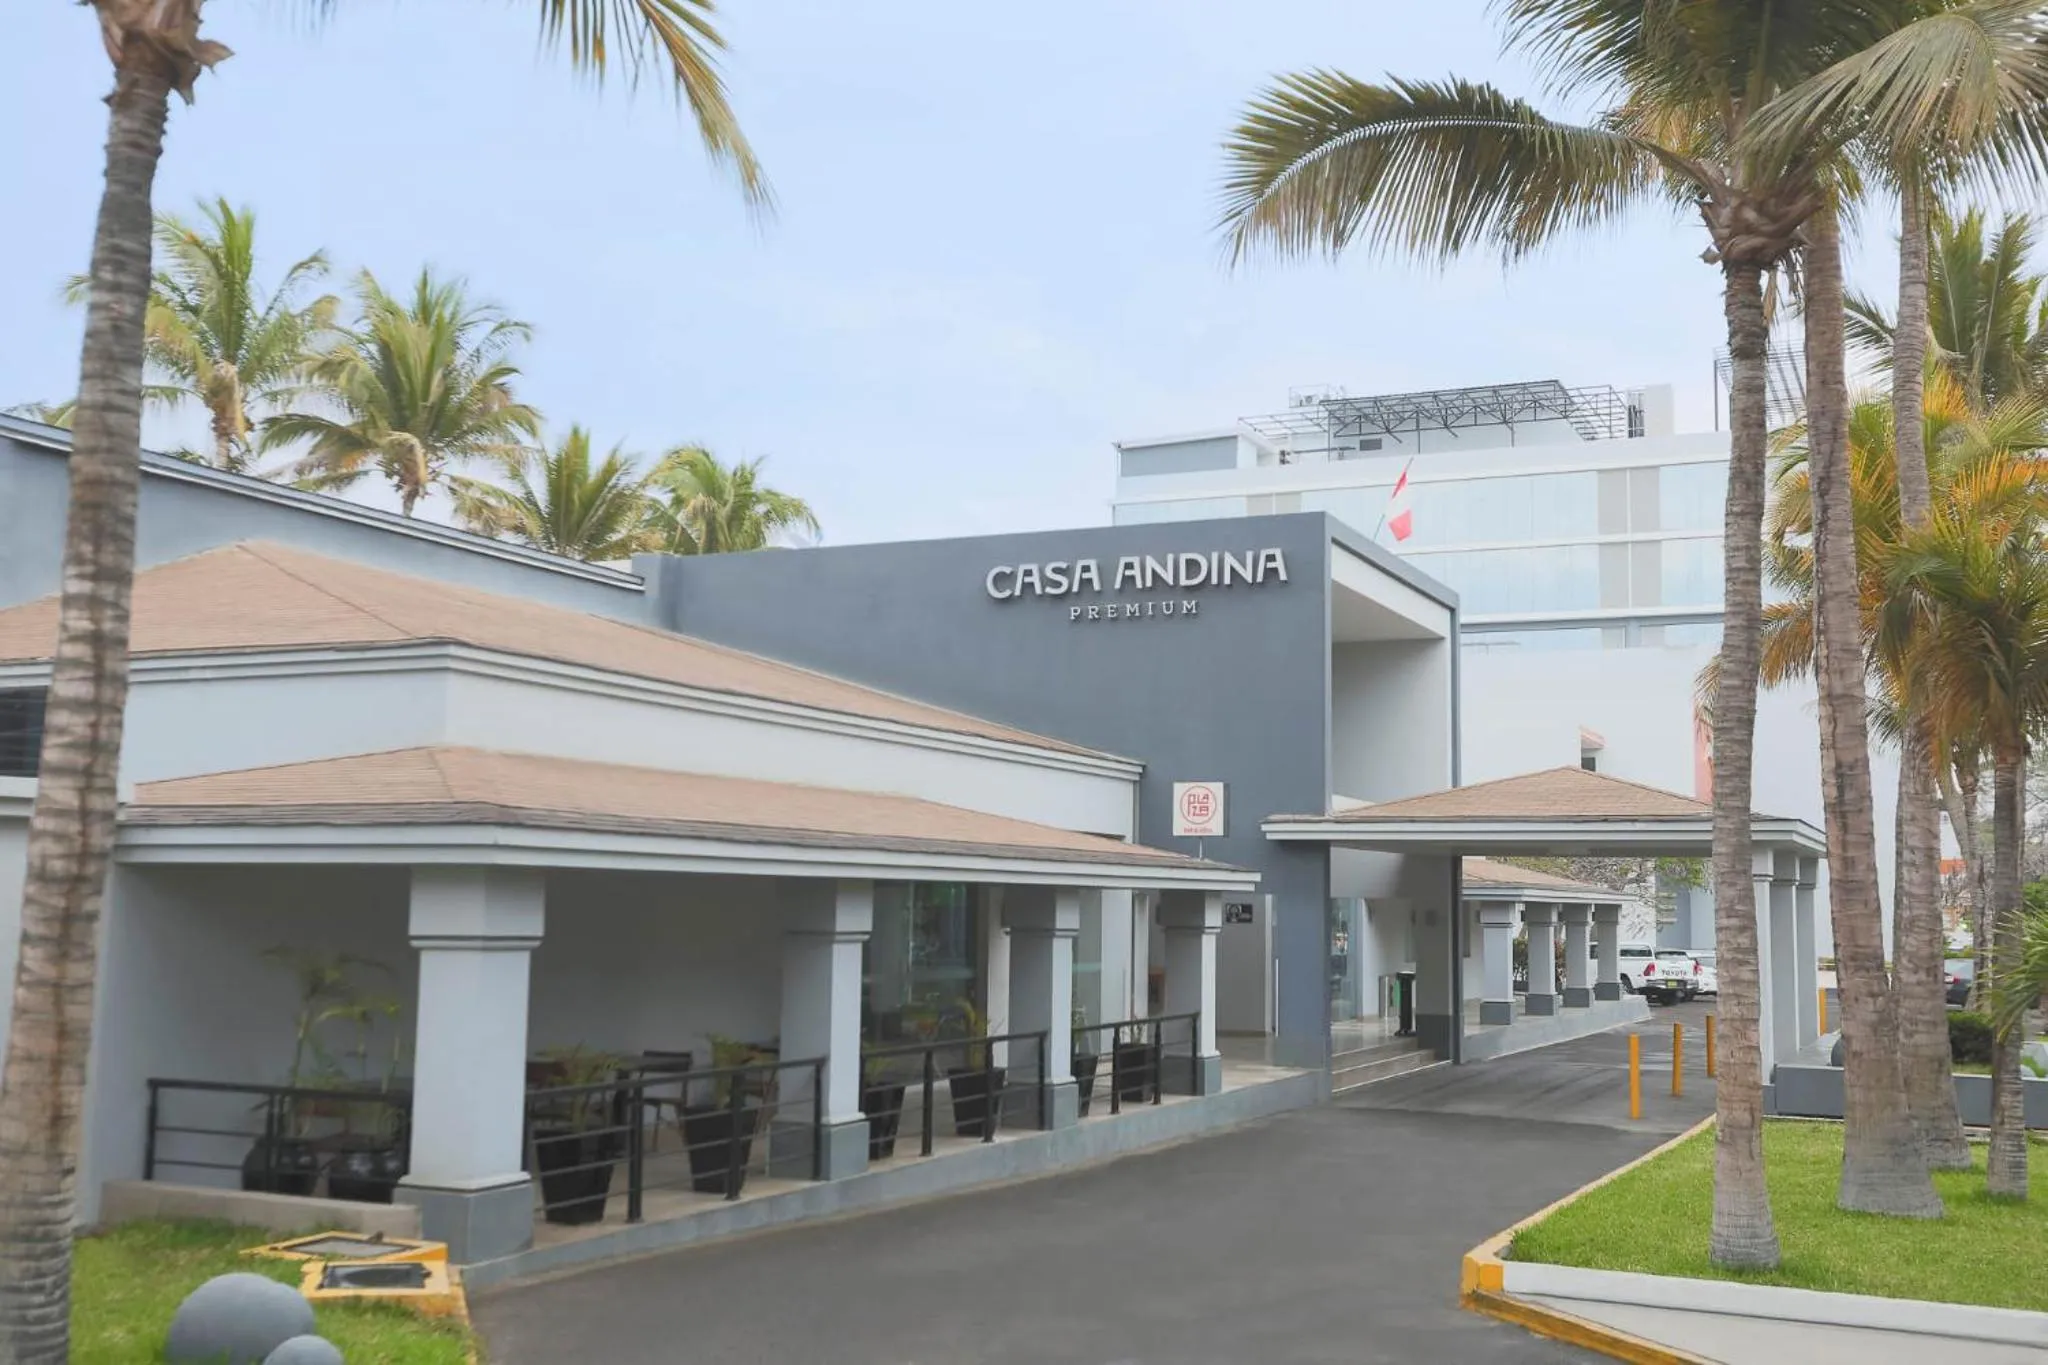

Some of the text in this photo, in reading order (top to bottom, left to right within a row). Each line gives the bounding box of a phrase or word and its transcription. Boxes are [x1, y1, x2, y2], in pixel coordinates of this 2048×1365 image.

[986, 548, 1288, 599] CASA ANDINA
[1069, 600, 1199, 621] PREMIUM
[1662, 969, 1687, 977] TOYOTA
